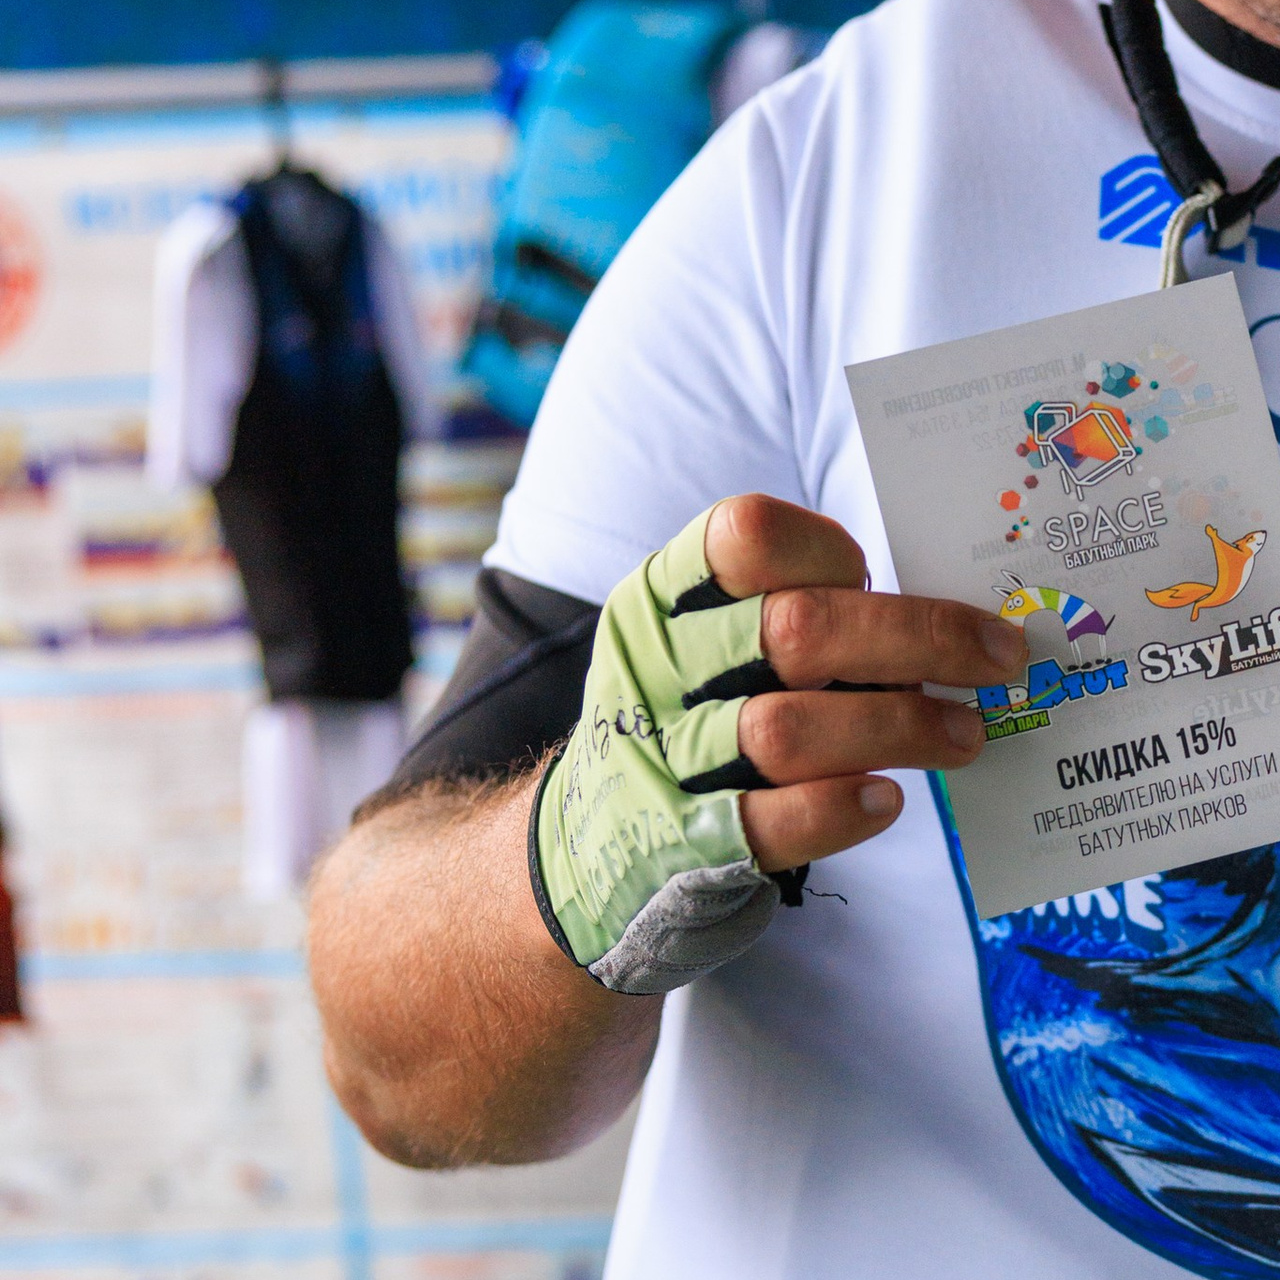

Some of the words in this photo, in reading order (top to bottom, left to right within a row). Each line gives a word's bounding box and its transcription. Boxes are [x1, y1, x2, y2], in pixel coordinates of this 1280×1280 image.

[1045, 492, 1168, 552] SPACE
[1064, 539, 1126, 570] БАТУТНЫЙ
[1126, 532, 1159, 555] ПАРК
[1230, 649, 1280, 672] БАТУТНЫЙ
[1016, 711, 1050, 733] ПАРК
[1056, 734, 1171, 790] СКИДКА
[1175, 716, 1237, 759] 15%
[1033, 778, 1177, 835] ПРЕДЪЯВИТЕЛЮ
[1178, 771, 1206, 798] НА
[1206, 752, 1278, 790] УСЛУГИ
[1077, 811, 1177, 857] БАТУТНЫХ
[1178, 793, 1248, 831] ПАРКОВ
